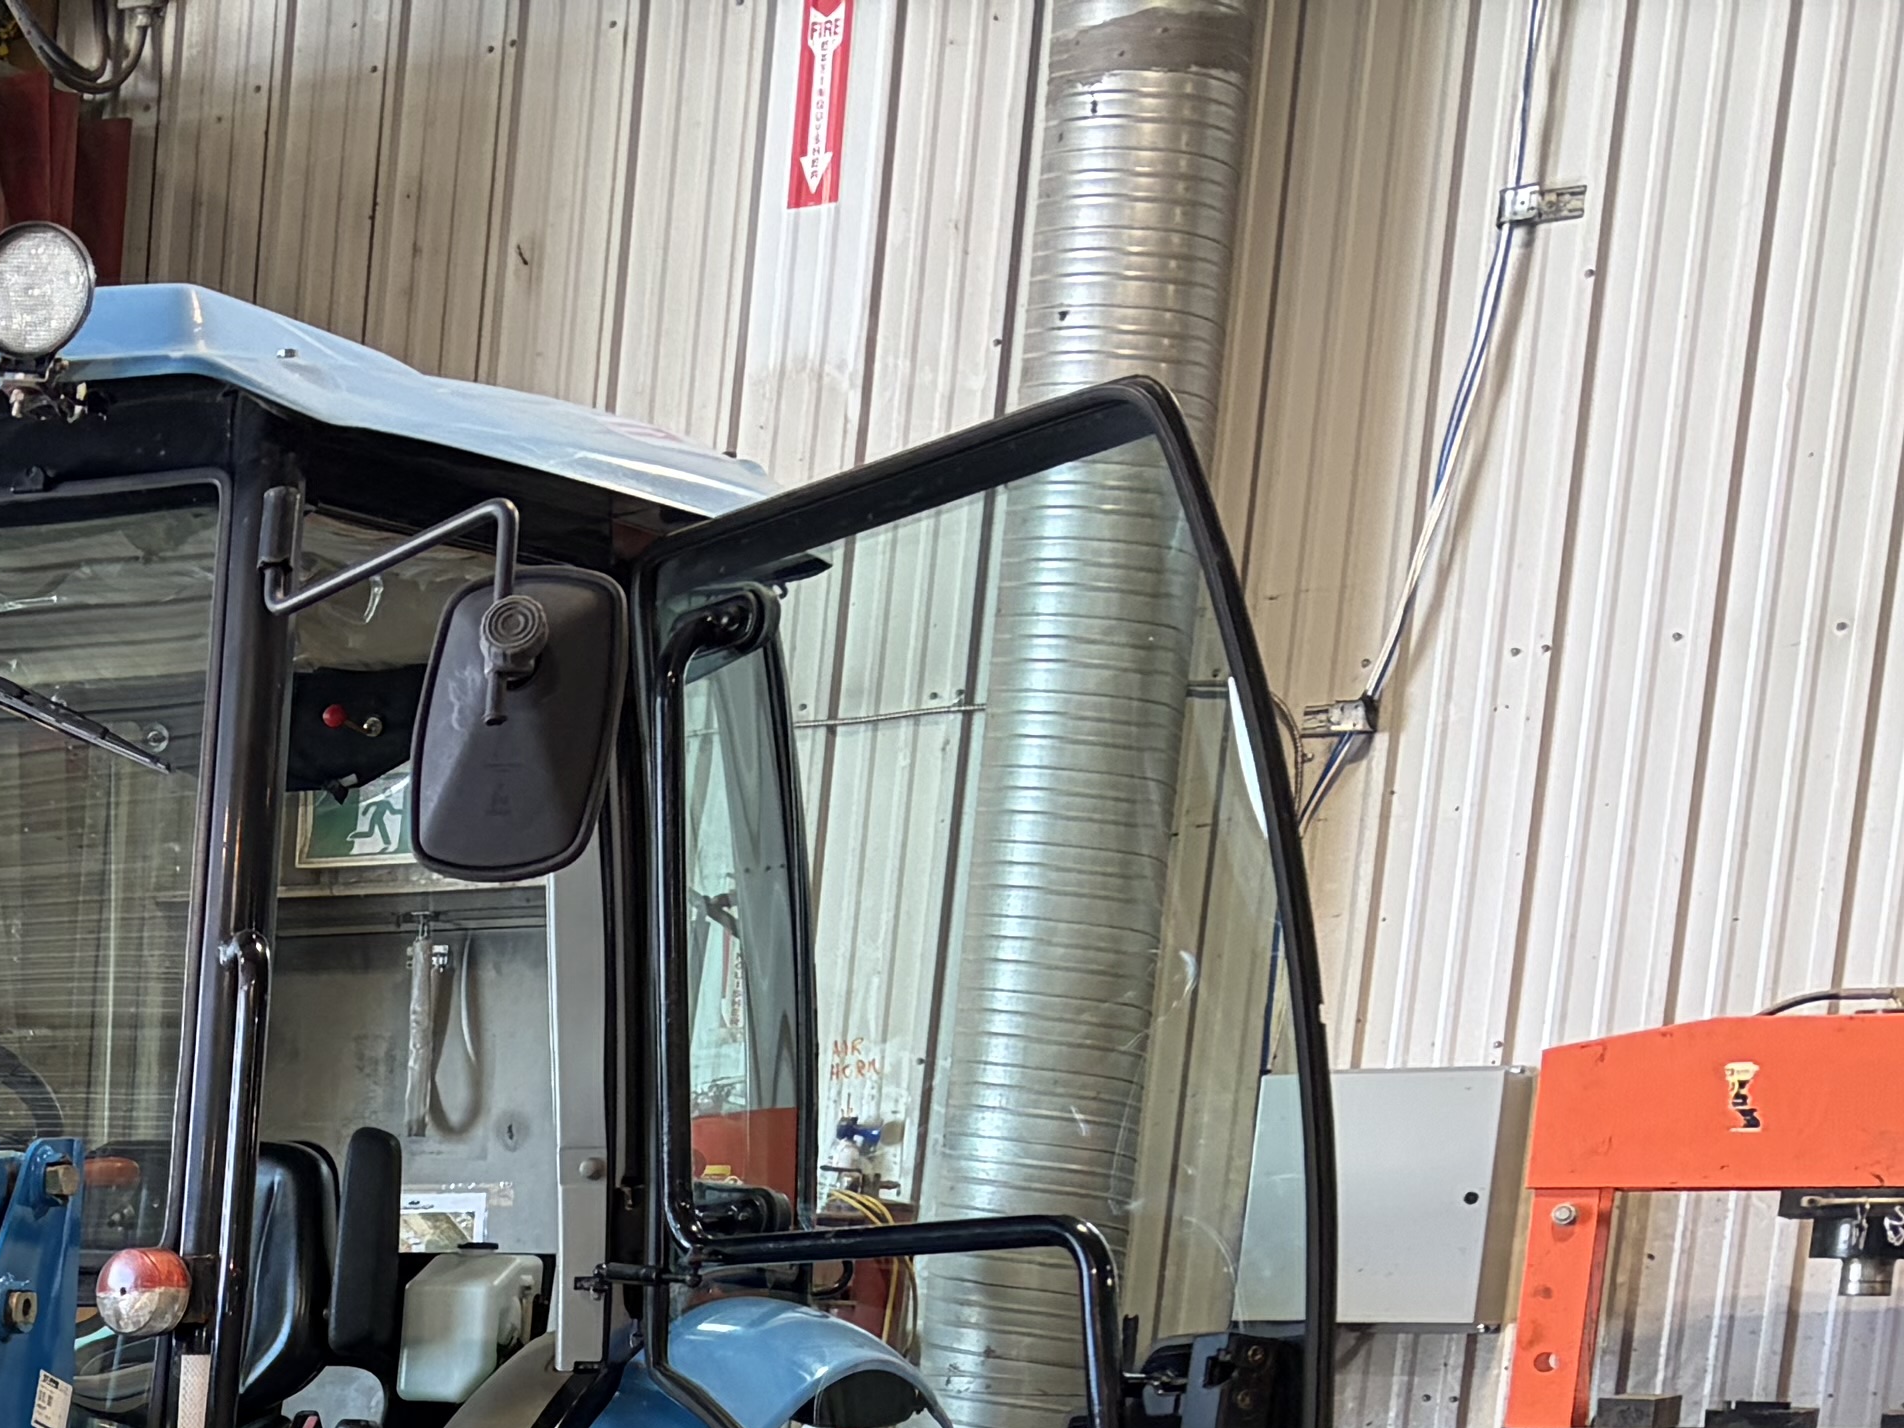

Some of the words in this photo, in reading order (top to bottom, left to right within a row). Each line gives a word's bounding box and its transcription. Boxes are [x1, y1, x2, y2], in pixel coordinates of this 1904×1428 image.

[810, 18, 841, 41] FIRE
[809, 40, 830, 180] EXTINGUISHER
[832, 1036, 865, 1058] AIR
[829, 1057, 883, 1081] HORN
